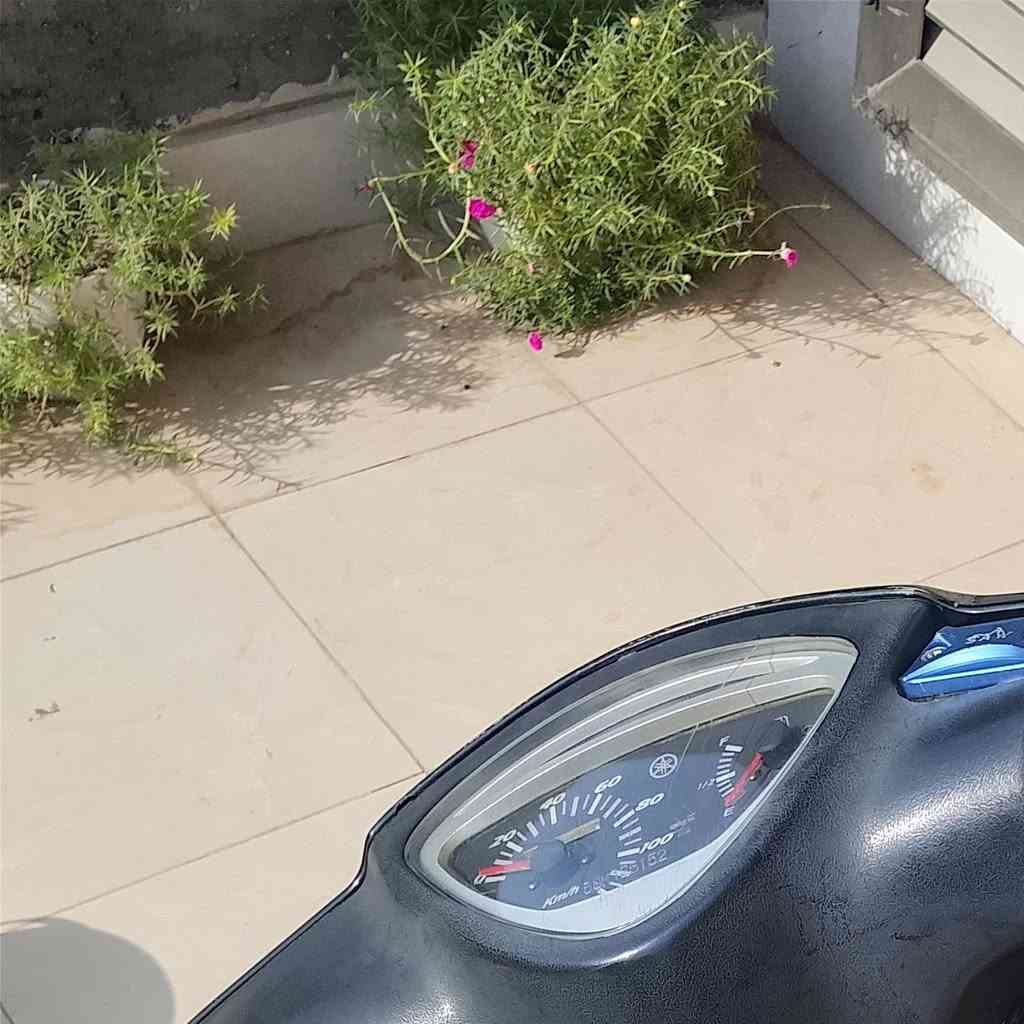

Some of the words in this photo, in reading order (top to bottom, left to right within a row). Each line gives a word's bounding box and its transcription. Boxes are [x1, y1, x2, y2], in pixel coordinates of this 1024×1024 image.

[594, 775, 622, 794] 60
[635, 793, 665, 812] 80
[488, 829, 517, 849] 20
[638, 832, 674, 854] 100
